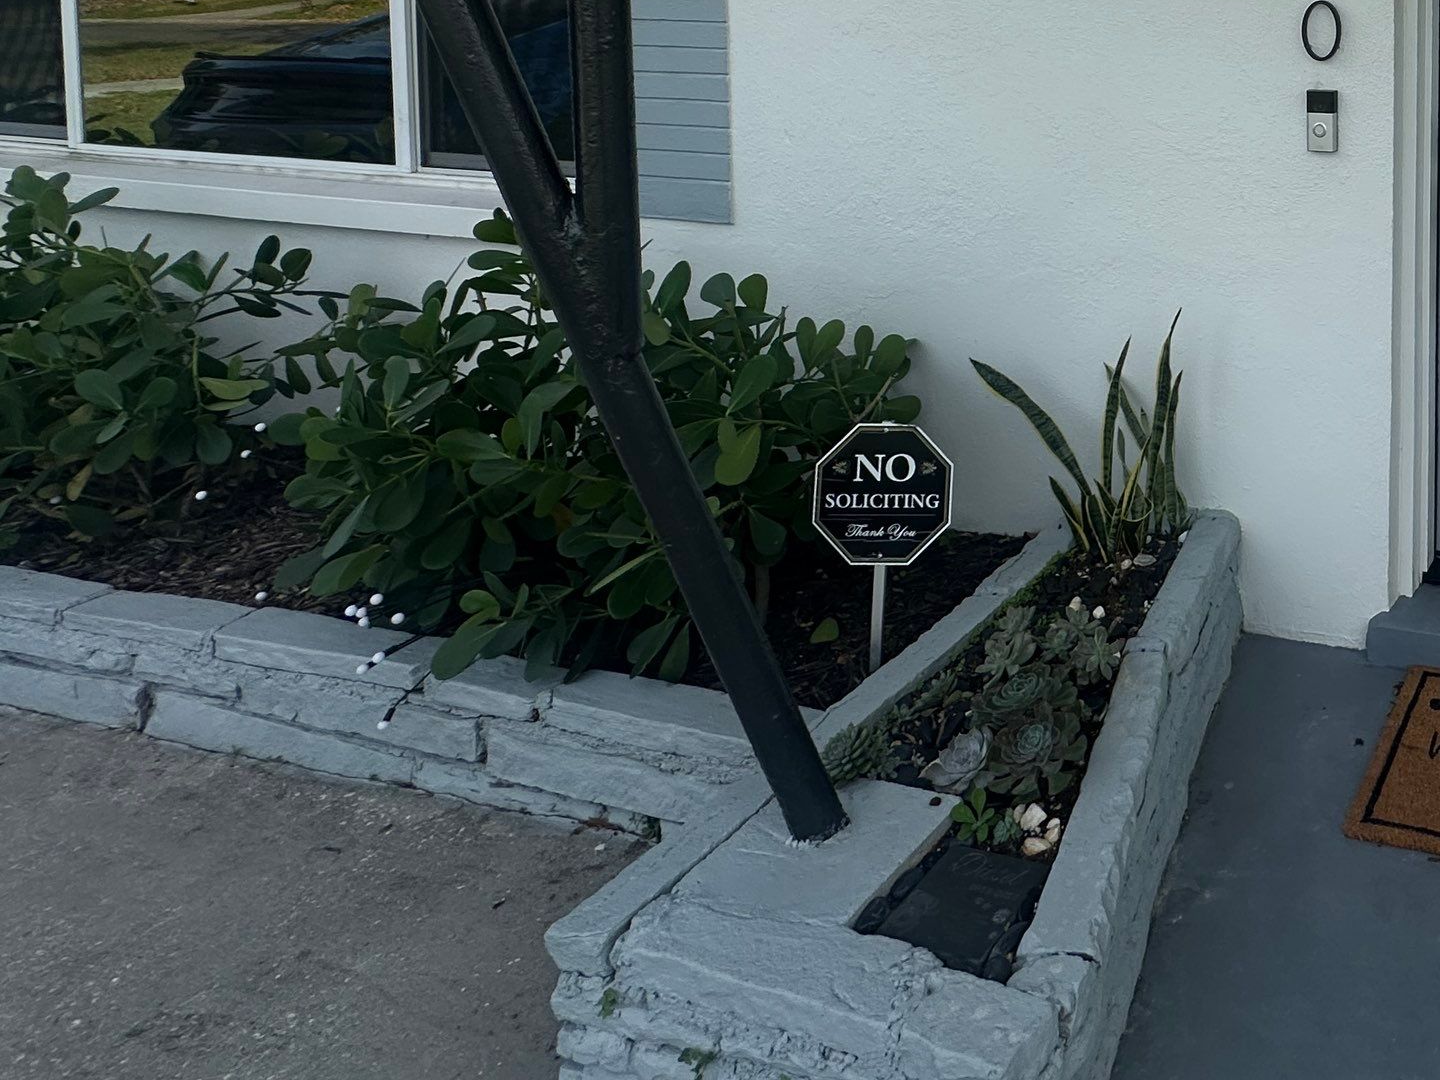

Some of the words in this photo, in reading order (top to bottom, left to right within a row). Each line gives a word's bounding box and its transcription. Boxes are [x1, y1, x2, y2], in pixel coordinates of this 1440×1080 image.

[852, 453, 916, 482] NO
[824, 493, 940, 509] SOLICITING
[845, 523, 885, 538] Thank
[887, 523, 917, 541] You
